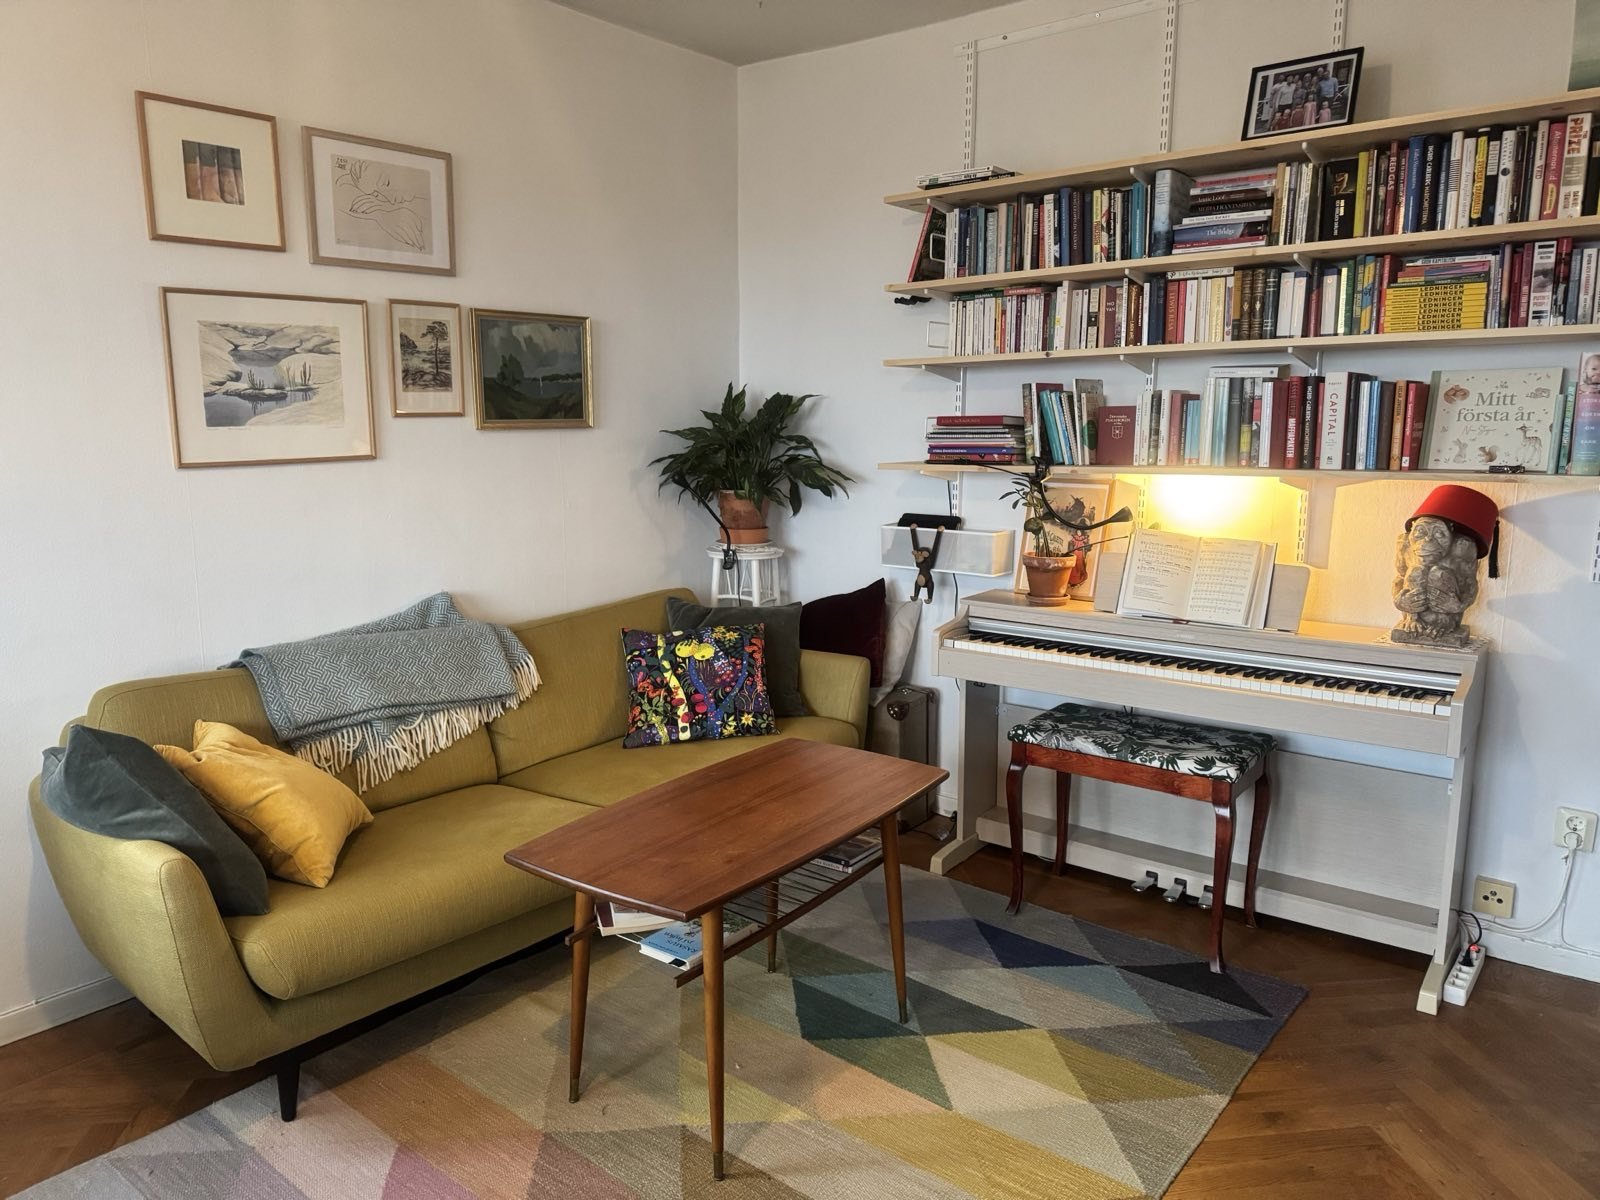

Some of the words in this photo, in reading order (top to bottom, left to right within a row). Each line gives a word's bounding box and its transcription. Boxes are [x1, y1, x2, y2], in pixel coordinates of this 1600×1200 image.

[1567, 117, 1585, 155] PRIZE
[1389, 156, 1397, 172] RED
[1424, 162, 1433, 186] CARLBERG
[1476, 160, 1485, 184] SVENSKA
[1535, 164, 1544, 179] VED
[1387, 174, 1396, 190] GAS
[1421, 186, 1430, 225] MARIONETTERNA
[1472, 185, 1483, 216] SKANDALER
[1572, 190, 1581, 208] DANIEL
[1168, 292, 1176, 313] LEWIS
[1168, 314, 1176, 330] RESA
[1476, 392, 1517, 406] Mitt
[1327, 392, 1339, 436] CAPITAL
[1456, 408, 1509, 422] första
[1515, 407, 1535, 422] år
[1286, 418, 1297, 458] MAFFIAPAKTEN
